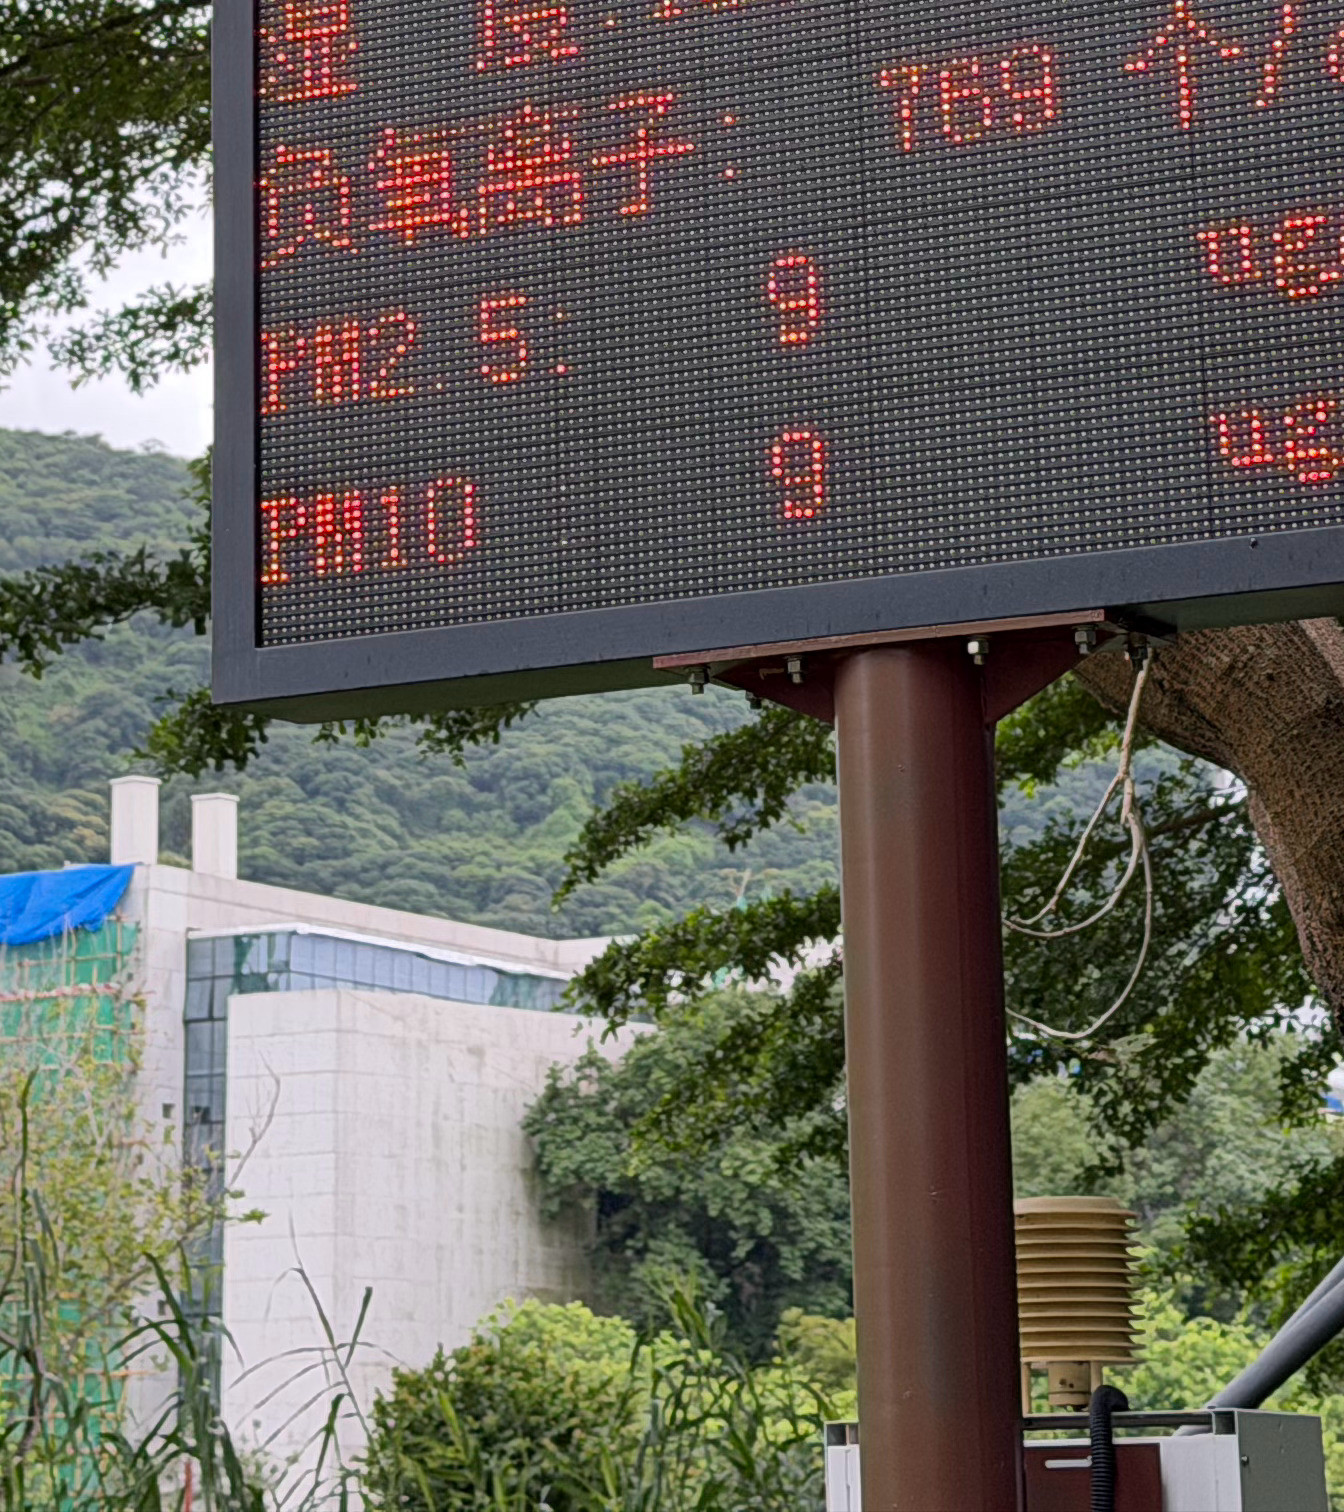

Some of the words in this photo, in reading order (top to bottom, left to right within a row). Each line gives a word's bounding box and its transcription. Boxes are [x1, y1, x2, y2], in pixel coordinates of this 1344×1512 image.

[878, 43, 1054, 150] 769
[766, 252, 821, 345] 9
[768, 426, 826, 518] 9
